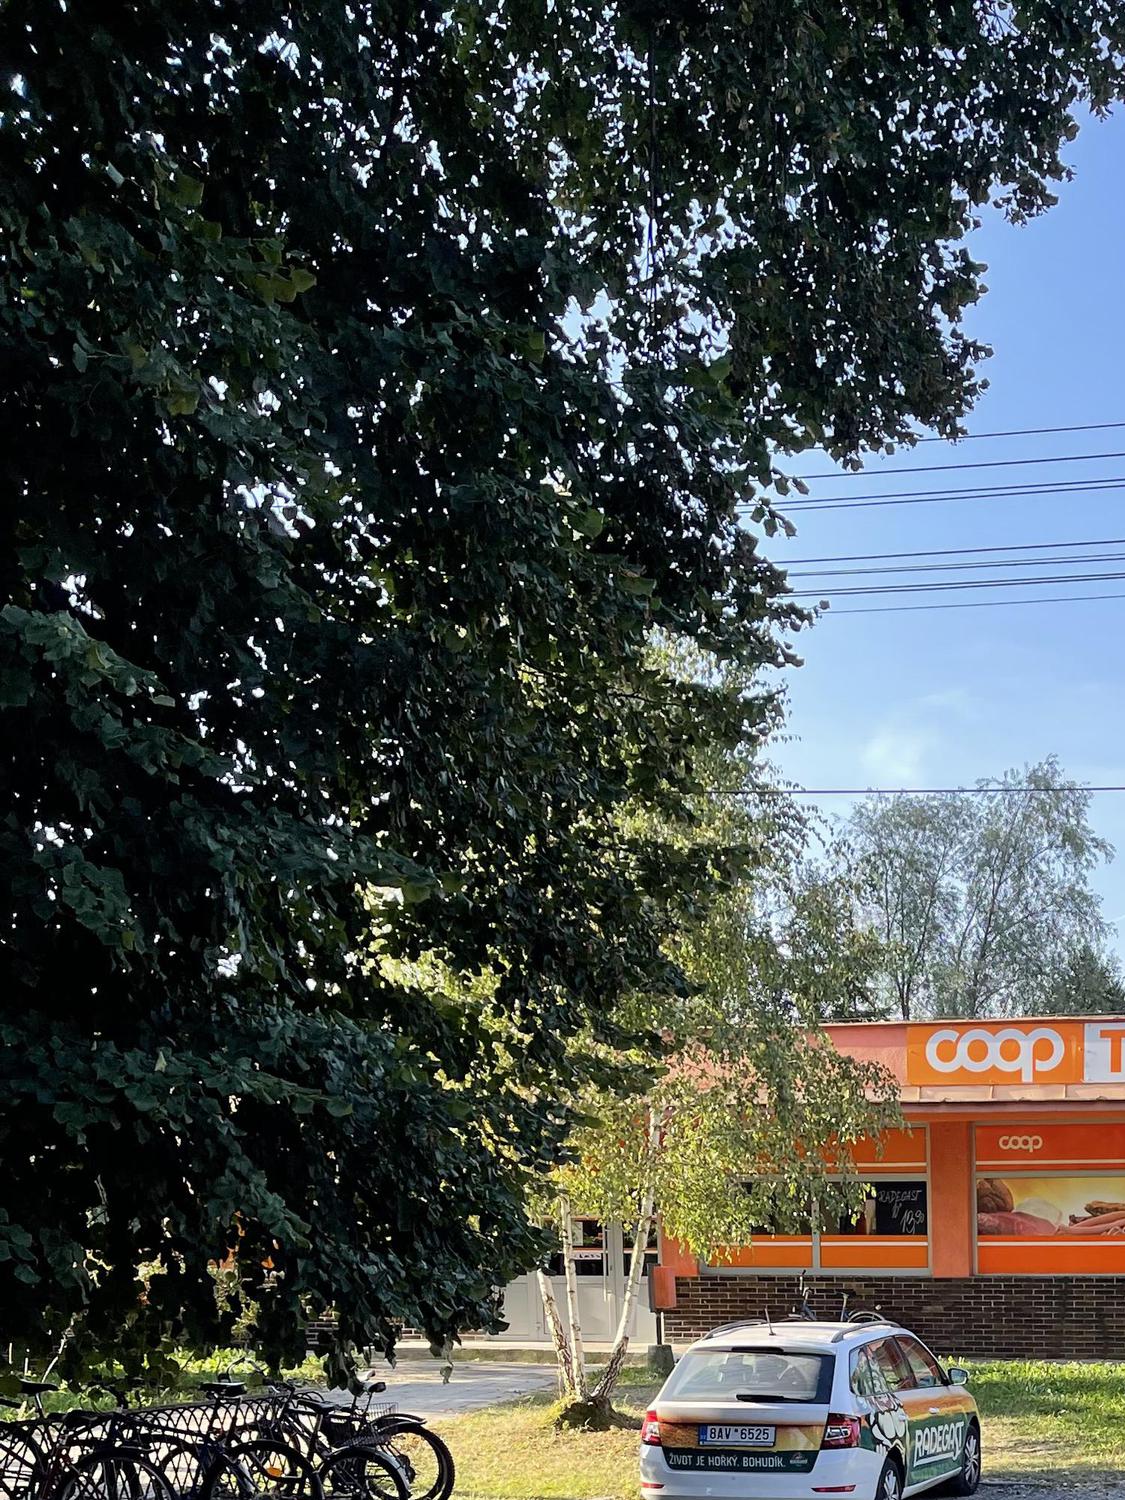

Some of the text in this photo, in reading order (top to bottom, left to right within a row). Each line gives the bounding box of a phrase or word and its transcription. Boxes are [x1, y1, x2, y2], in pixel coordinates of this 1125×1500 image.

[925, 1028, 1065, 1082] coop
[999, 1135, 1043, 1153] coop
[878, 1190, 922, 1203] RADEGAST
[709, 1427, 731, 1440] 8AV
[740, 1428, 769, 1440] 6525
[914, 1421, 964, 1467] RADEGAST
[669, 1452, 692, 1465] ŽIVOT
[696, 1455, 705, 1466] JE
